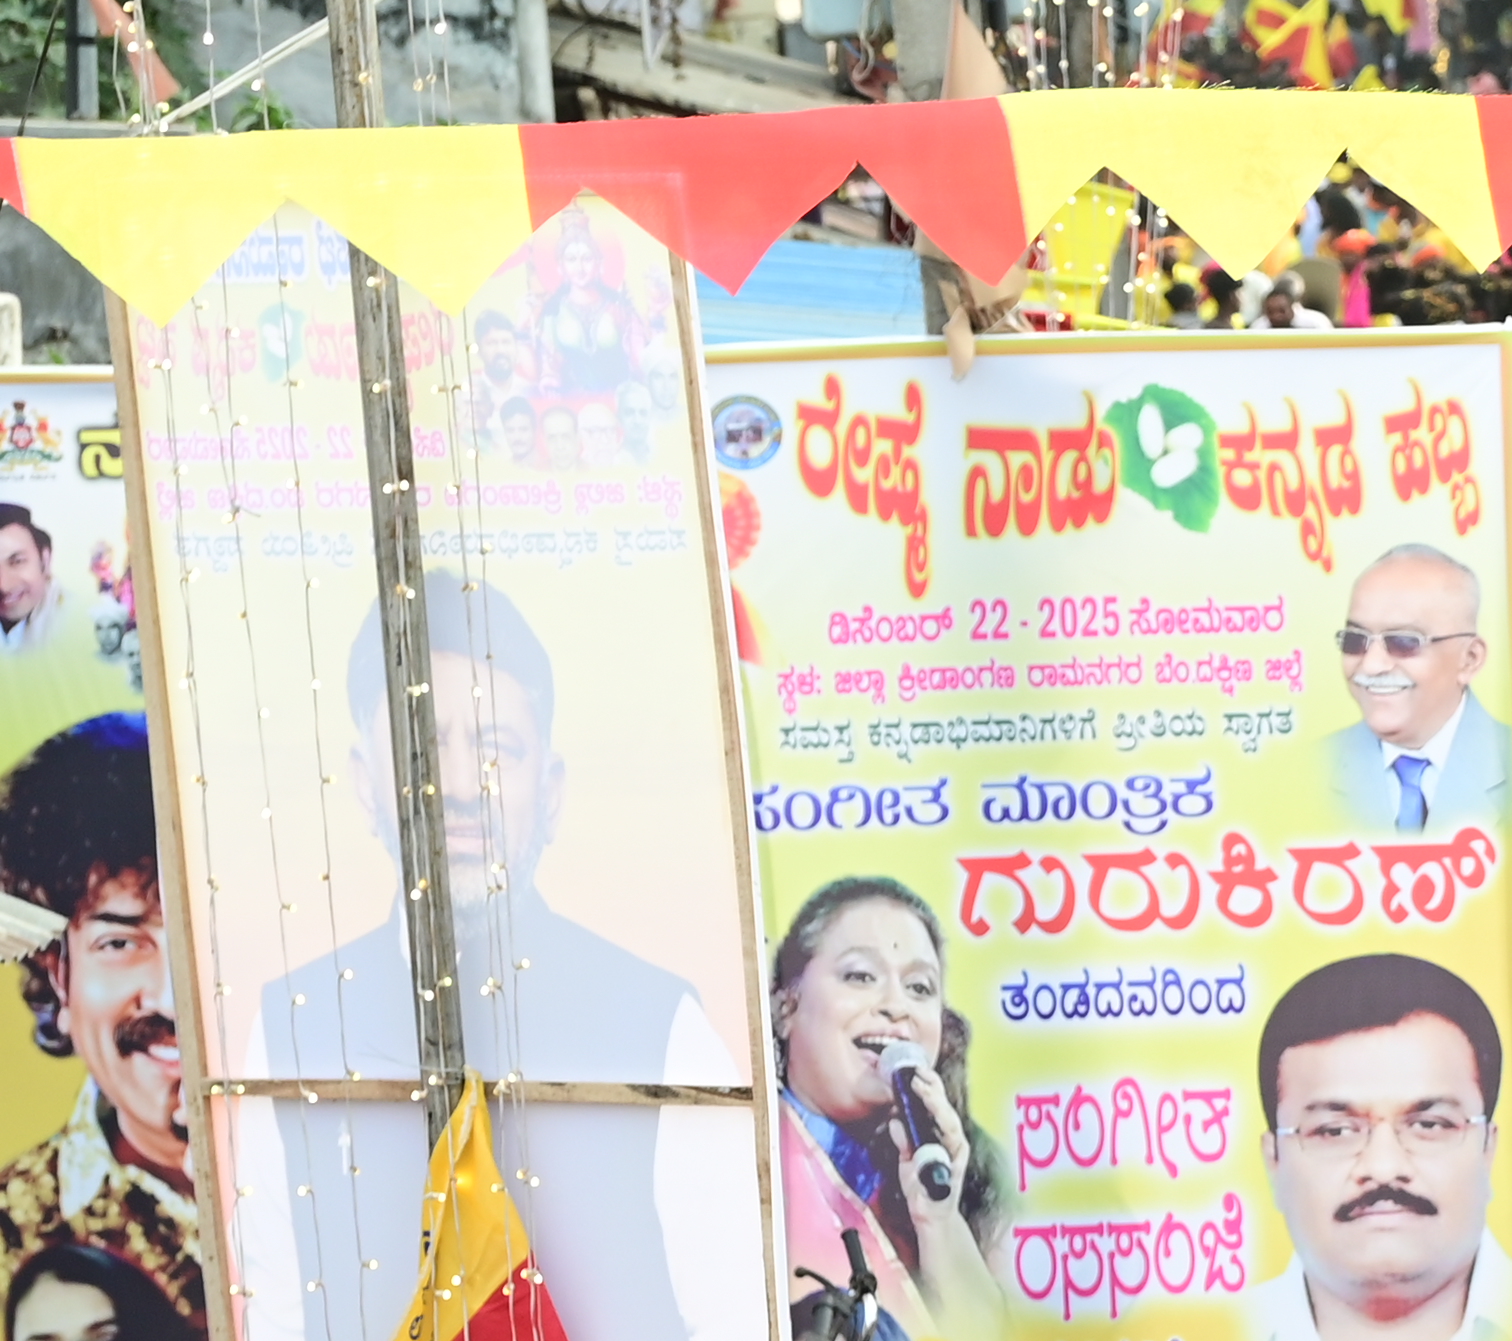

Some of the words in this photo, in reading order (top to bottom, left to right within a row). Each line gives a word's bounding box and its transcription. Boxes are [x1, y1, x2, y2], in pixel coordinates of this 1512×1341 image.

[797, 374, 930, 597] ರೇಷ್ಮೆ
[964, 389, 1118, 538] ನಾಡು
[1218, 389, 1363, 571] ಕನ್ನಡ
[1383, 377, 1482, 535] ಹಬ್ಬ
[829, 605, 953, 645] ಡಿಸೆಂಬರ್
[970, 598, 1010, 640] 22
[1038, 596, 1120, 638] 2025
[1129, 596, 1285, 635] ಸೋಮವಾರ
[777, 664, 822, 714] ಸ್ಥಳ:
[834, 669, 886, 704] ಜಿಲ್ಲಾ
[899, 659, 1015, 701] ಕ್ರೀಡಾಂಗಣ
[1027, 654, 1142, 688] ರಾಮನಗರ
[1265, 649, 1304, 692] ಜಿಲ್ಲೆ
[778, 719, 854, 762] ಸಮಸ್ತ
[868, 711, 1097, 762] ಕನ್ನಡಾಭಿಮಾನಿಗಳಿಗೆ
[1113, 707, 1205, 751] ಪ್ರೀತಿಯ
[1222, 706, 1293, 751] ಸ್ವಾಗತ
[980, 767, 1215, 835] ಮಾಂತ್ರಿಕ
[957, 827, 1497, 937] ಗುರುಕಿರಣ್
[1000, 965, 1246, 1022] ತಂಡದವರಿಂದ
[1015, 1077, 1232, 1193] ಸಂಗೀತ
[1013, 1192, 1246, 1320] ರಸಸಂಜೆ
